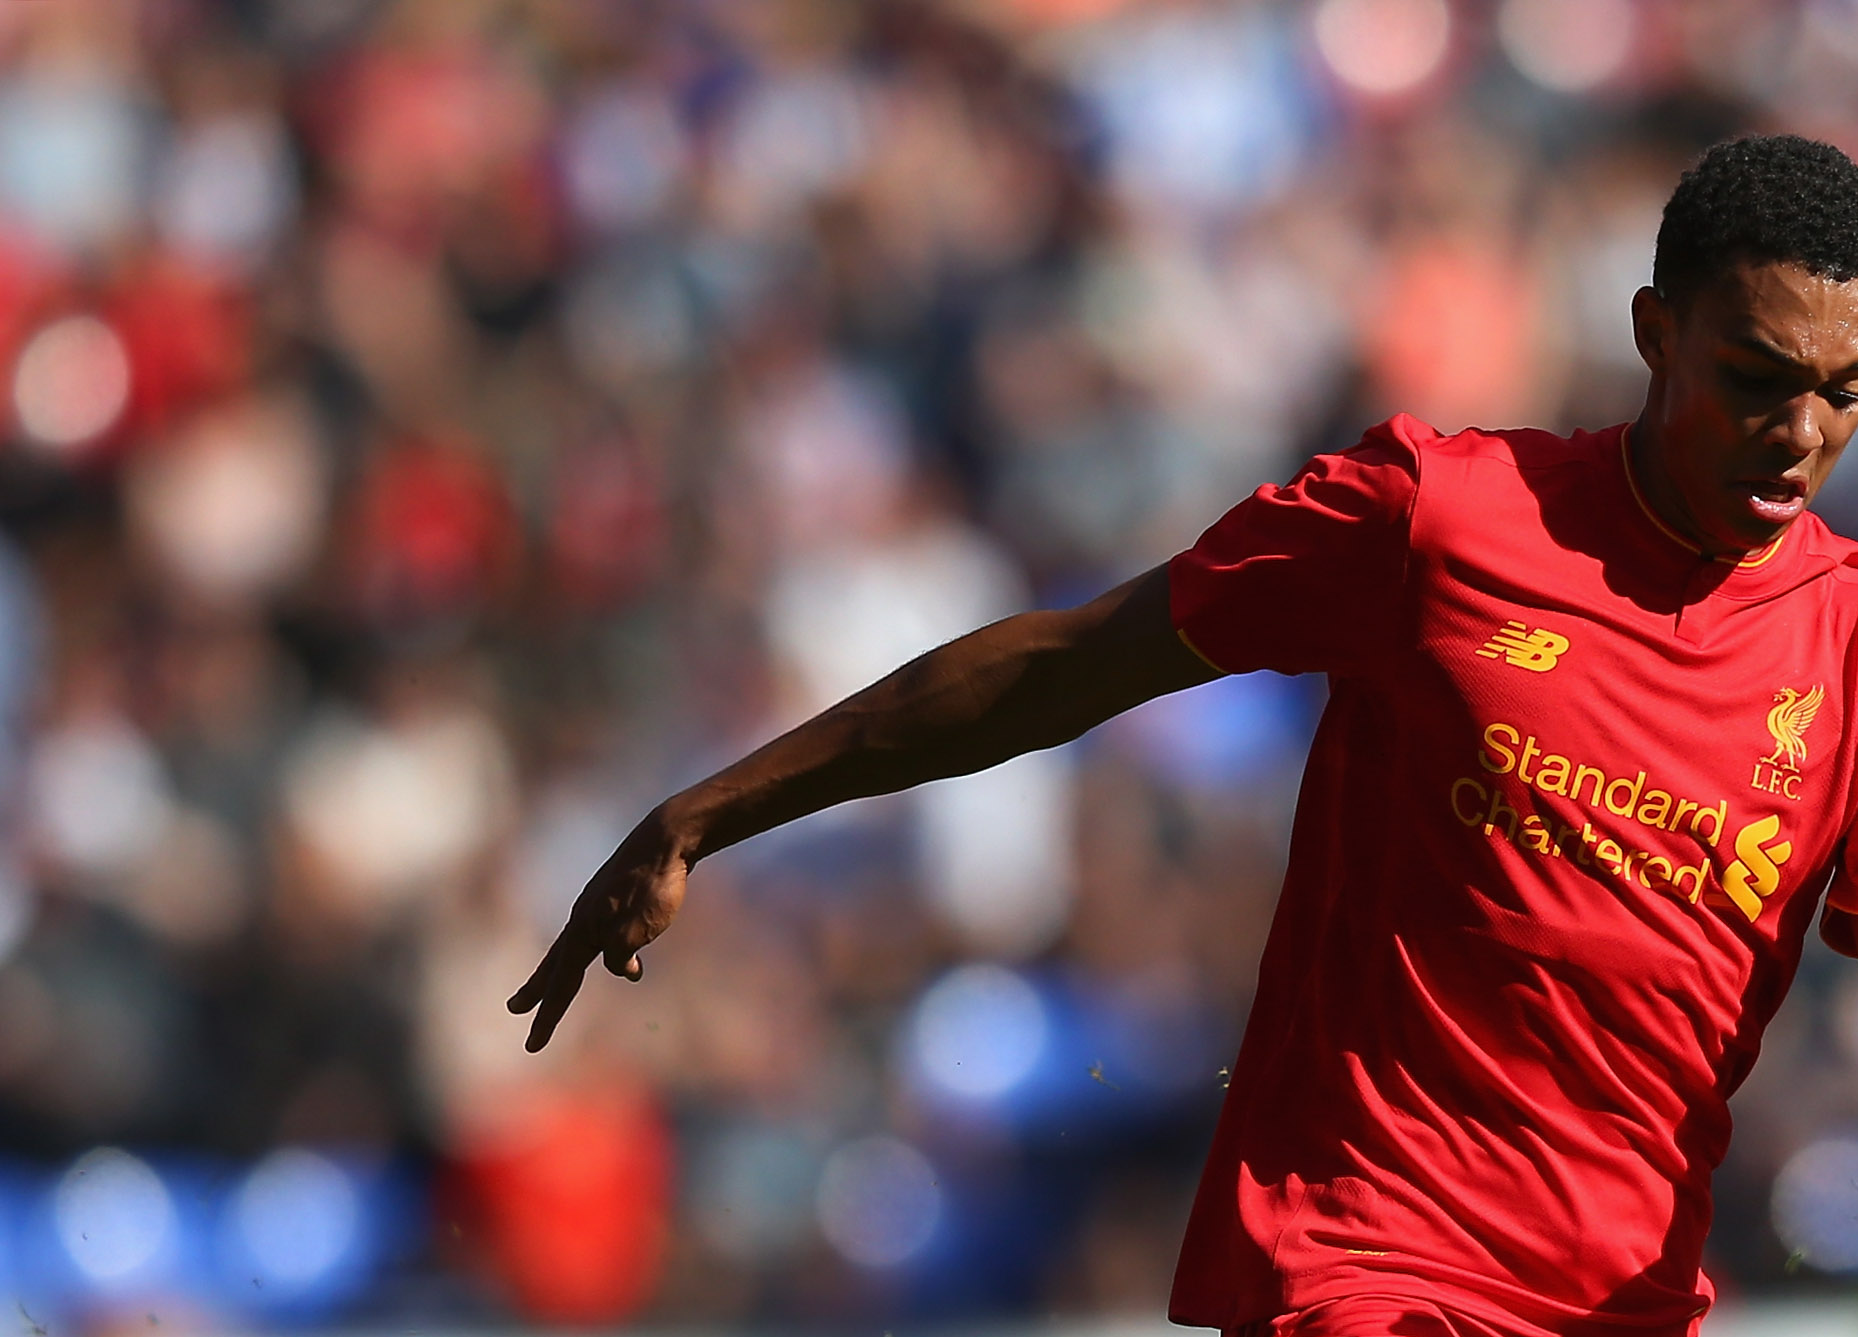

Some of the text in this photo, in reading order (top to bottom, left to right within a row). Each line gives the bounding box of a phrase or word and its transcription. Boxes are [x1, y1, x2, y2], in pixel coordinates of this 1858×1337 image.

[1451, 777, 1711, 905] Chartered
[1478, 722, 1728, 848] Standard
[1751, 764, 1802, 801] L.F.C.
